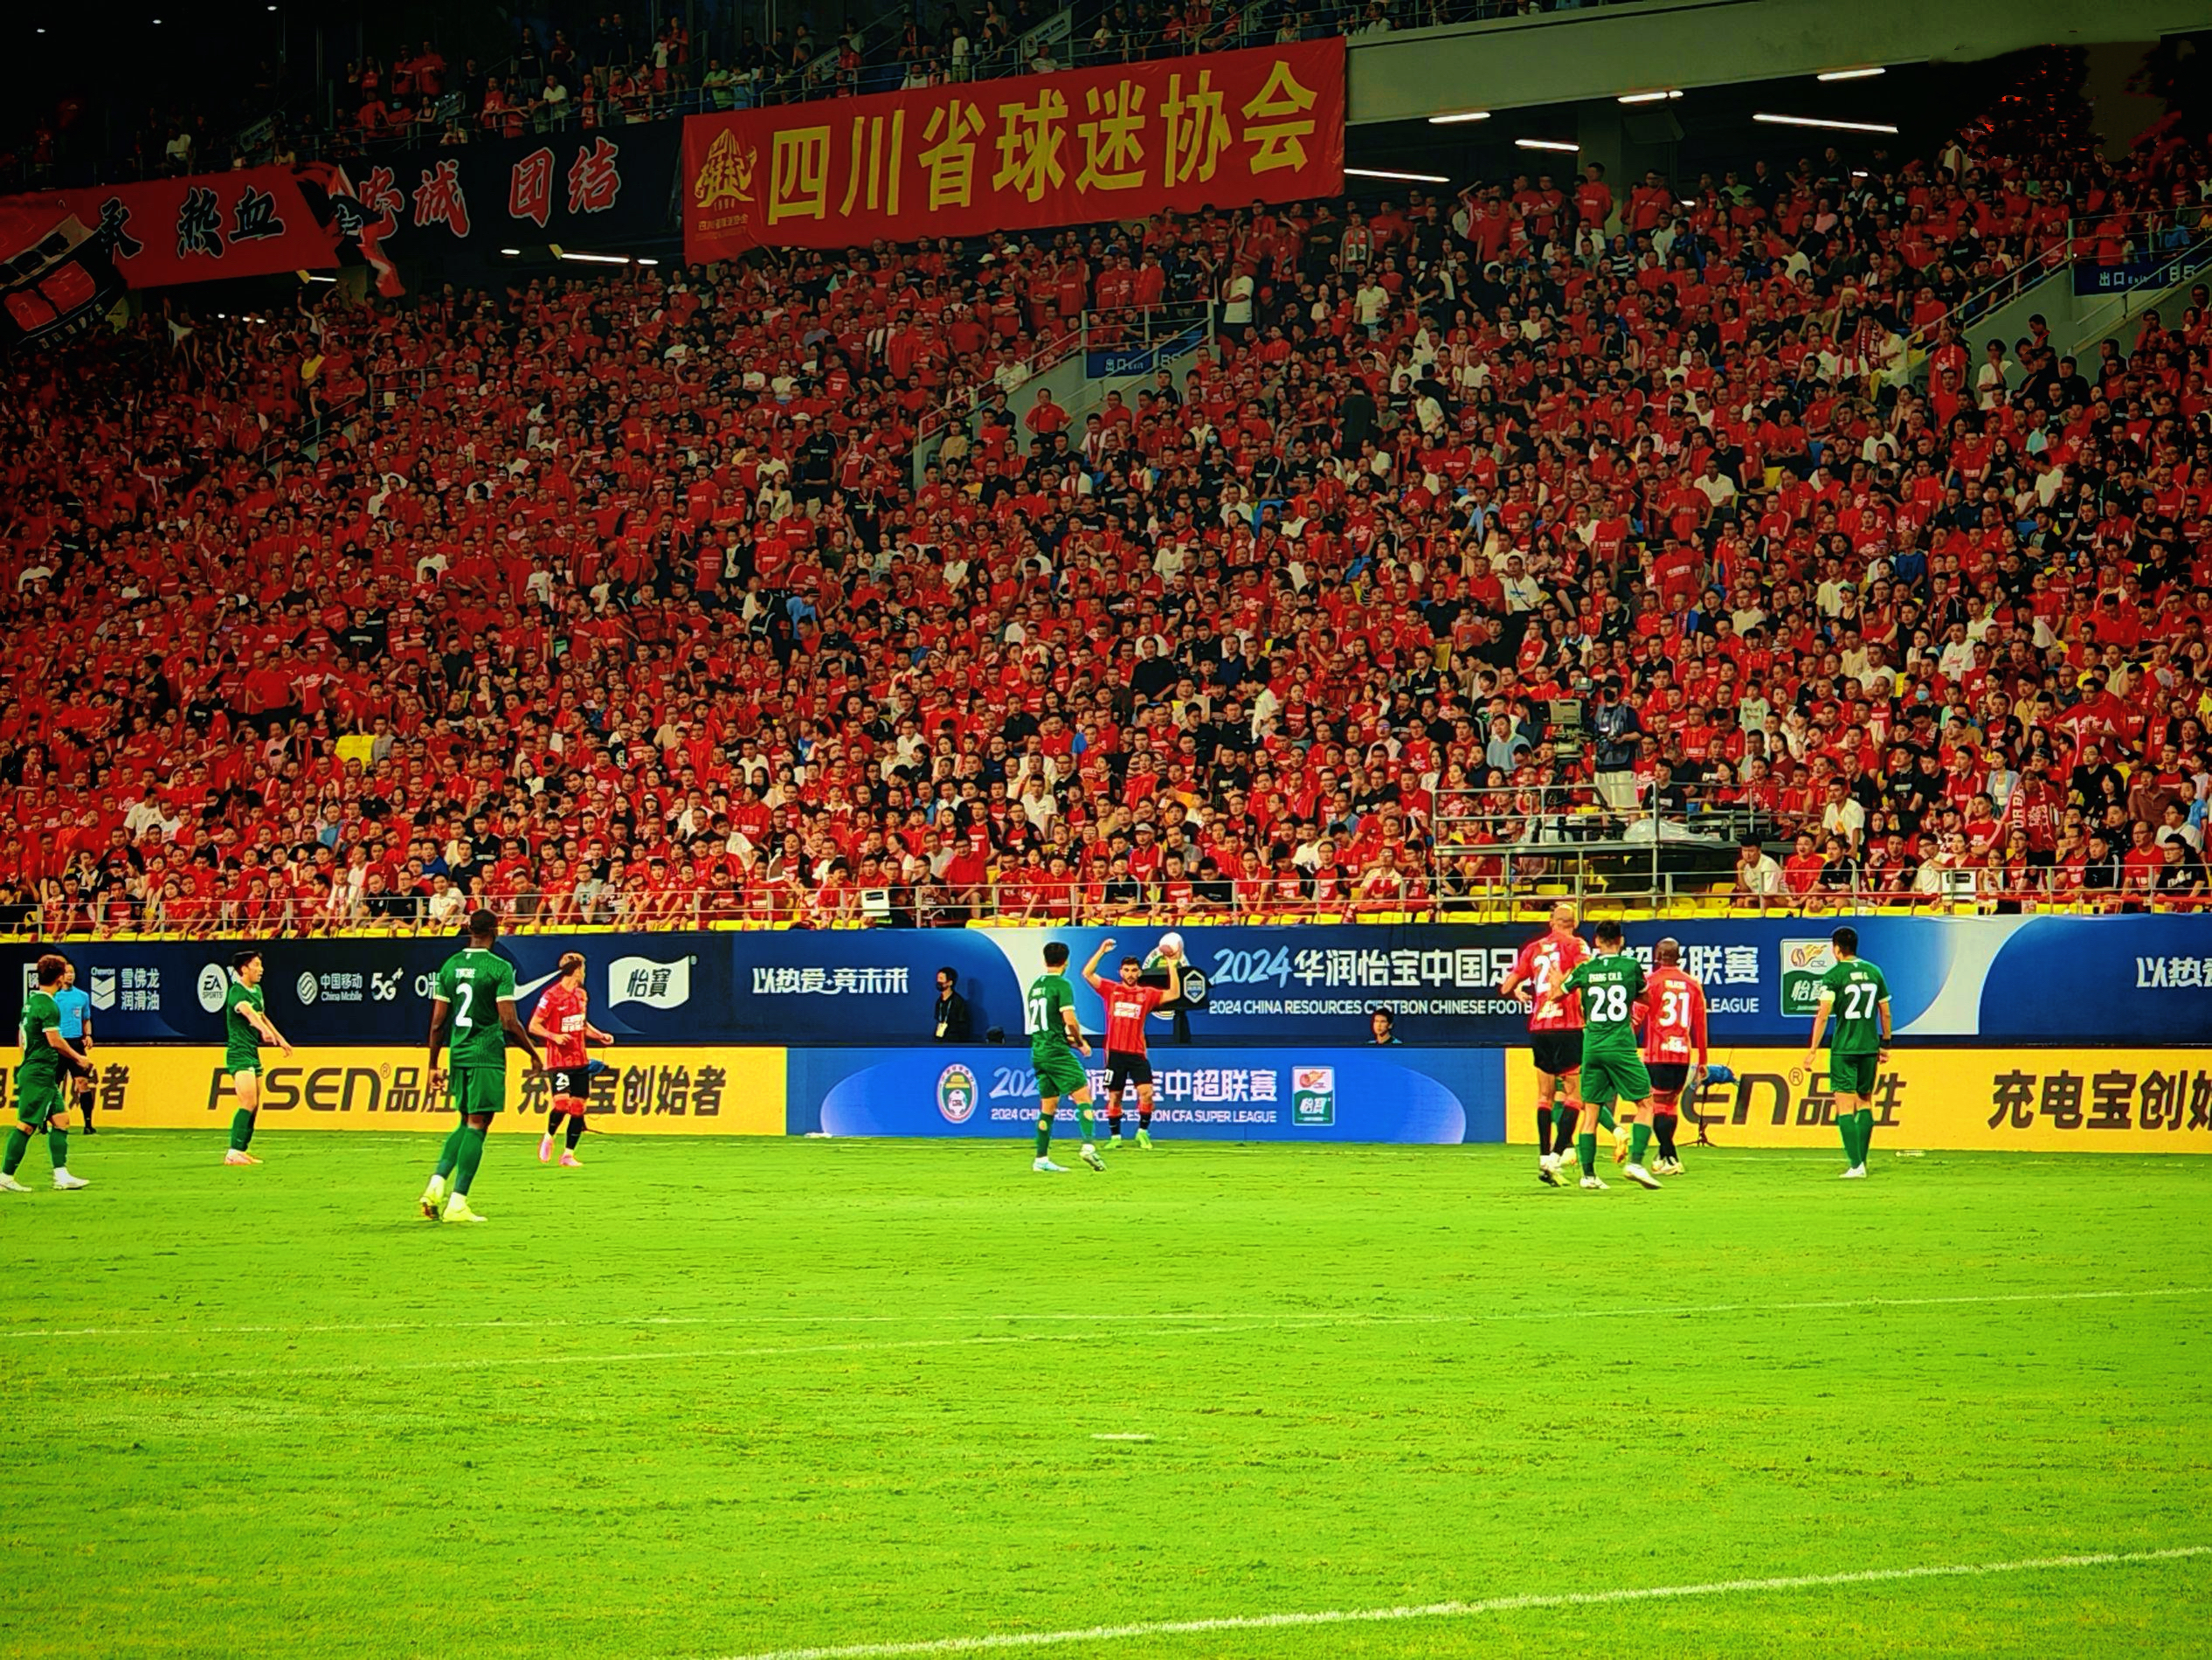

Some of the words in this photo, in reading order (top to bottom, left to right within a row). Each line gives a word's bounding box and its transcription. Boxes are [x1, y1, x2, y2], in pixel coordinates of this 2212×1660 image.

[767, 59, 1318, 226] 四川省球迷协会
[2099, 271, 2125, 287] 出口
[121, 967, 160, 988] 雪佛龙
[203, 975, 223, 991] EA
[320, 972, 363, 989] 中国移动
[121, 990, 160, 1011] 润滑油
[321, 991, 340, 1001] China
[341, 991, 363, 1001] Mobile
[455, 982, 474, 1027] 2
[1208, 999, 1242, 1014] 2024
[1244, 999, 1283, 1014] CHINA
[1285, 999, 1362, 1014] RESOURCES
[1430, 999, 1487, 1014] CHINESE
[1488, 999, 1533, 1014] FOOTB
[1587, 985, 1628, 1022] 28
[1844, 983, 1877, 1020] 27
[1029, 997, 1049, 1032] 21
[1659, 991, 1690, 1028] 31
[517, 1064, 727, 1117] 充宝创始者
[992, 1108, 1019, 1121] 2024
[1172, 1110, 1194, 1122] CFA
[1195, 1110, 1232, 1123] SUPER
[1234, 1110, 1277, 1123] LEAGUE
